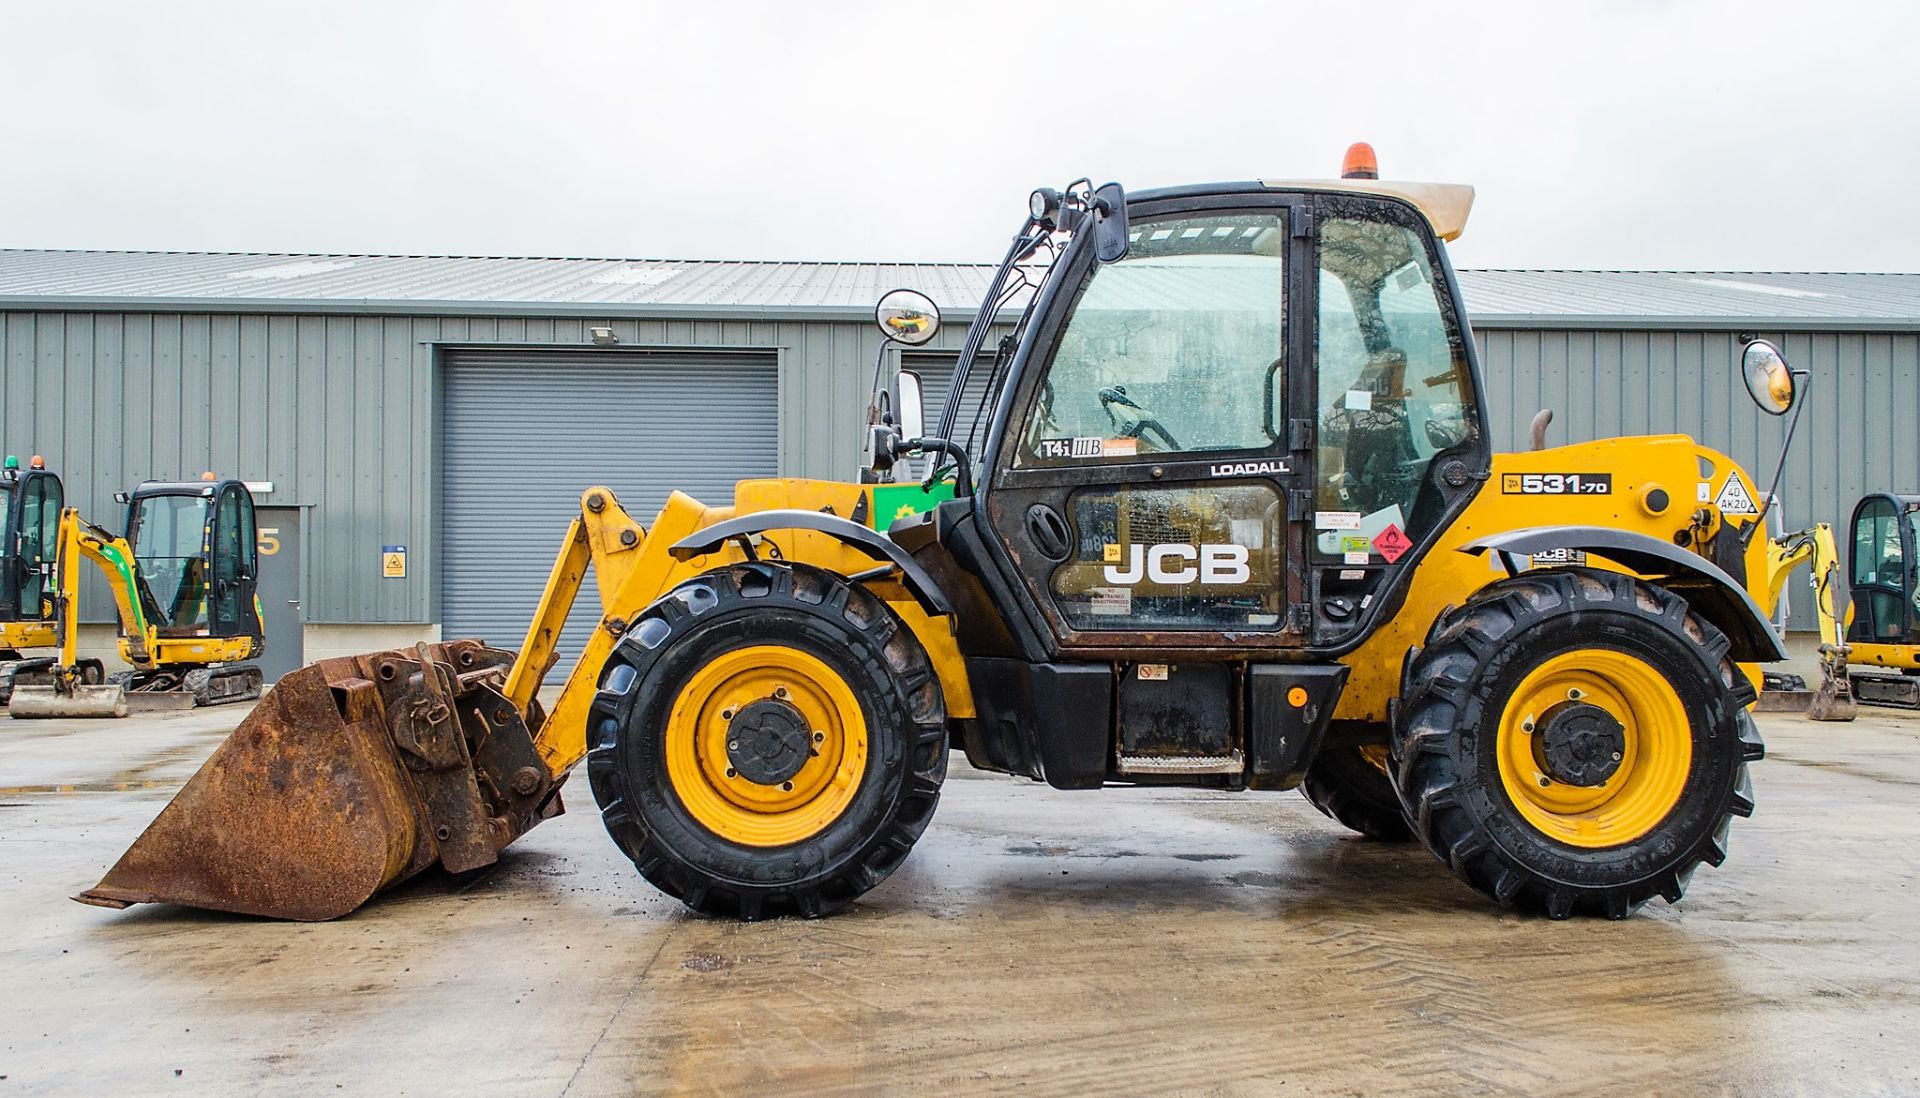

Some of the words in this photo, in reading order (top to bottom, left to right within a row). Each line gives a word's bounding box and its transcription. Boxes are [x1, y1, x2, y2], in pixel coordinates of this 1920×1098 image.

[1211, 461, 1290, 477] LOADALL
[1721, 500, 1747, 509] AK20
[257, 528, 280, 555] 5
[1103, 544, 1250, 584] JCB
